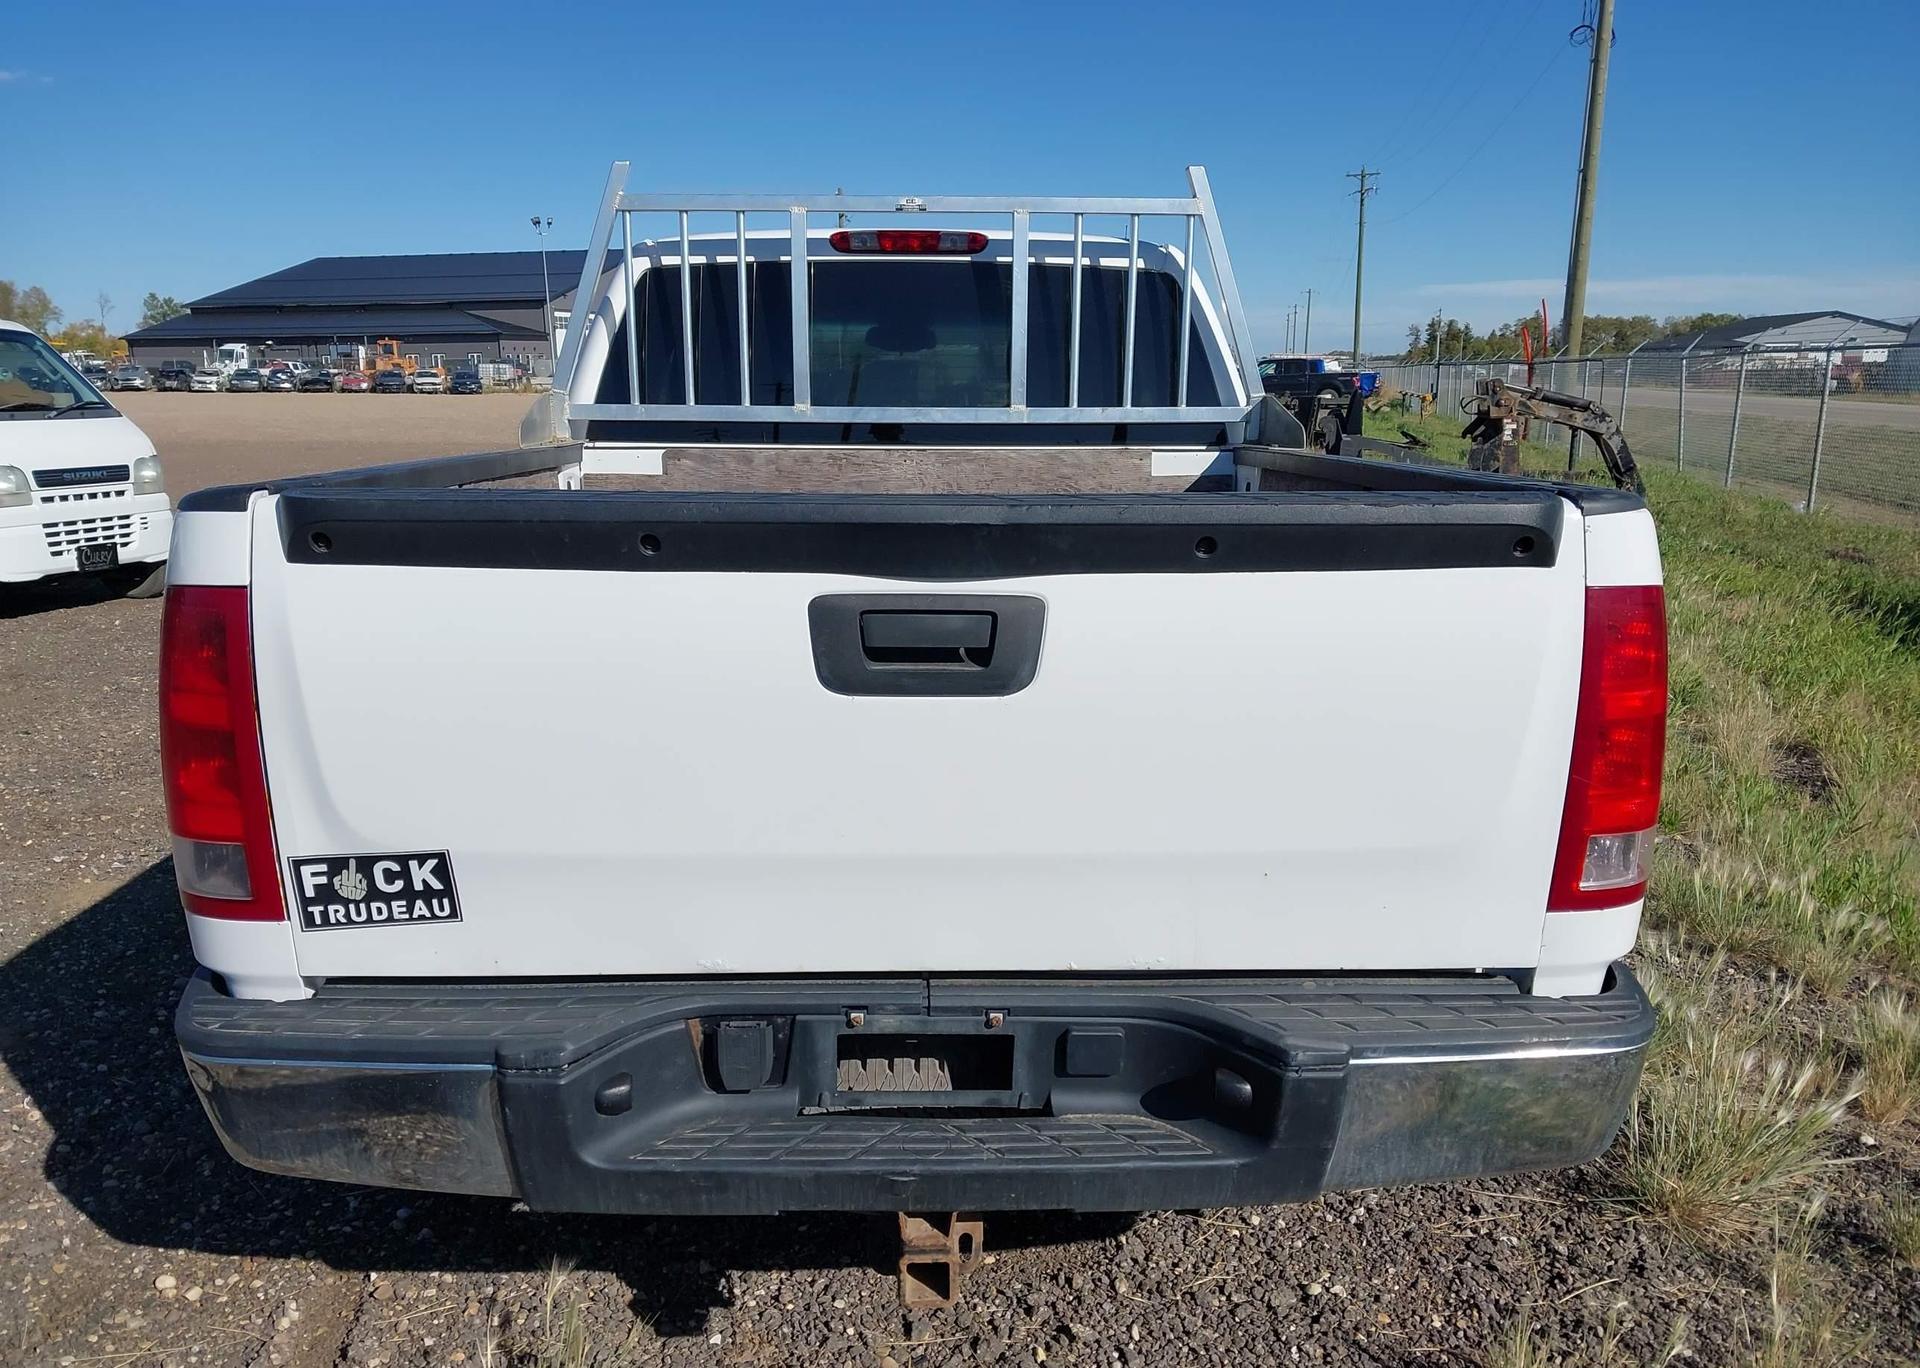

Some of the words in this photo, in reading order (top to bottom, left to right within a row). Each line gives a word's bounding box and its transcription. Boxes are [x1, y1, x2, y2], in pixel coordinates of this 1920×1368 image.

[62, 470, 107, 481] SUZUKI
[300, 858, 444, 898] FCK
[308, 898, 451, 925] TRUDEAU
